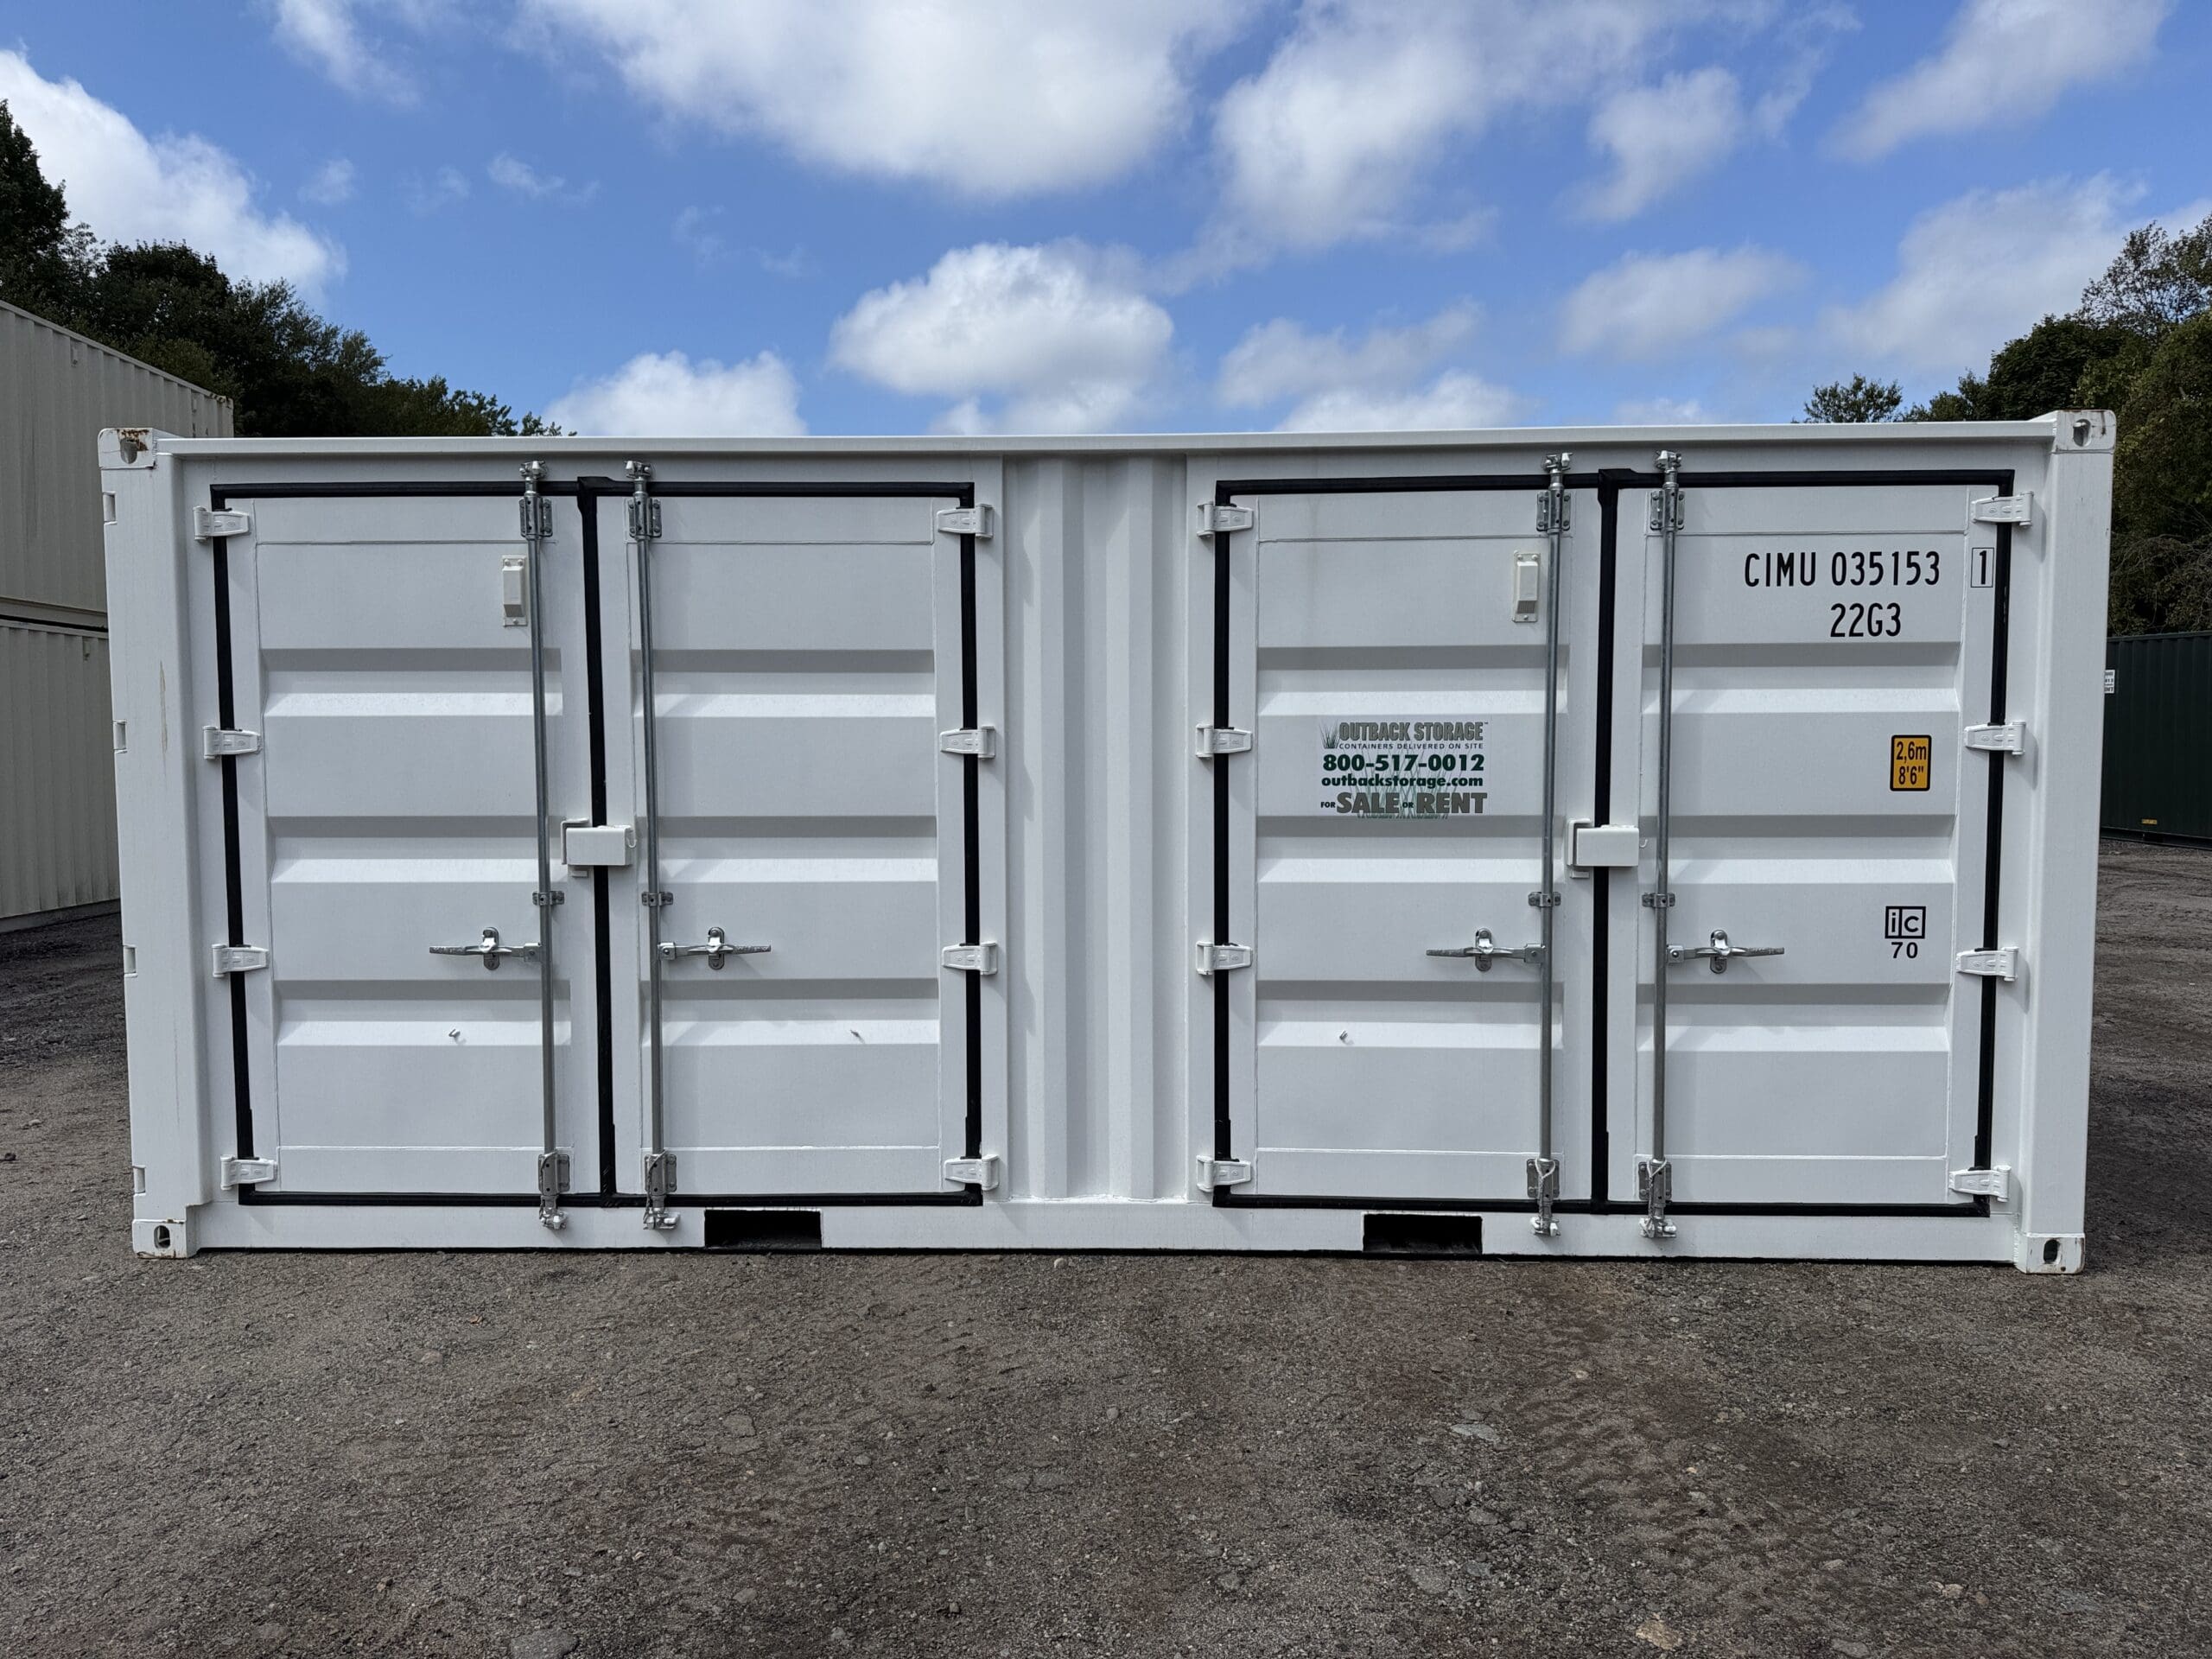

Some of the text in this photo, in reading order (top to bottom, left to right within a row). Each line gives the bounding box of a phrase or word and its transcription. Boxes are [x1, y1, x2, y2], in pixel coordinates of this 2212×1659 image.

[1744, 550, 1987, 588] CIMU 035153 1
[1829, 602, 1902, 638] 22G3
[1339, 721, 1410, 741] OUTBACK
[1323, 753, 1485, 772] 800-517-0012
[1896, 741, 1927, 764] 2,6m
[1321, 773, 1484, 789] outbackstorage.com
[1898, 766, 1924, 785] 8'6"
[1336, 792, 1400, 814] SALE
[1415, 792, 1488, 814] RENT
[1891, 941, 1918, 959] 70
